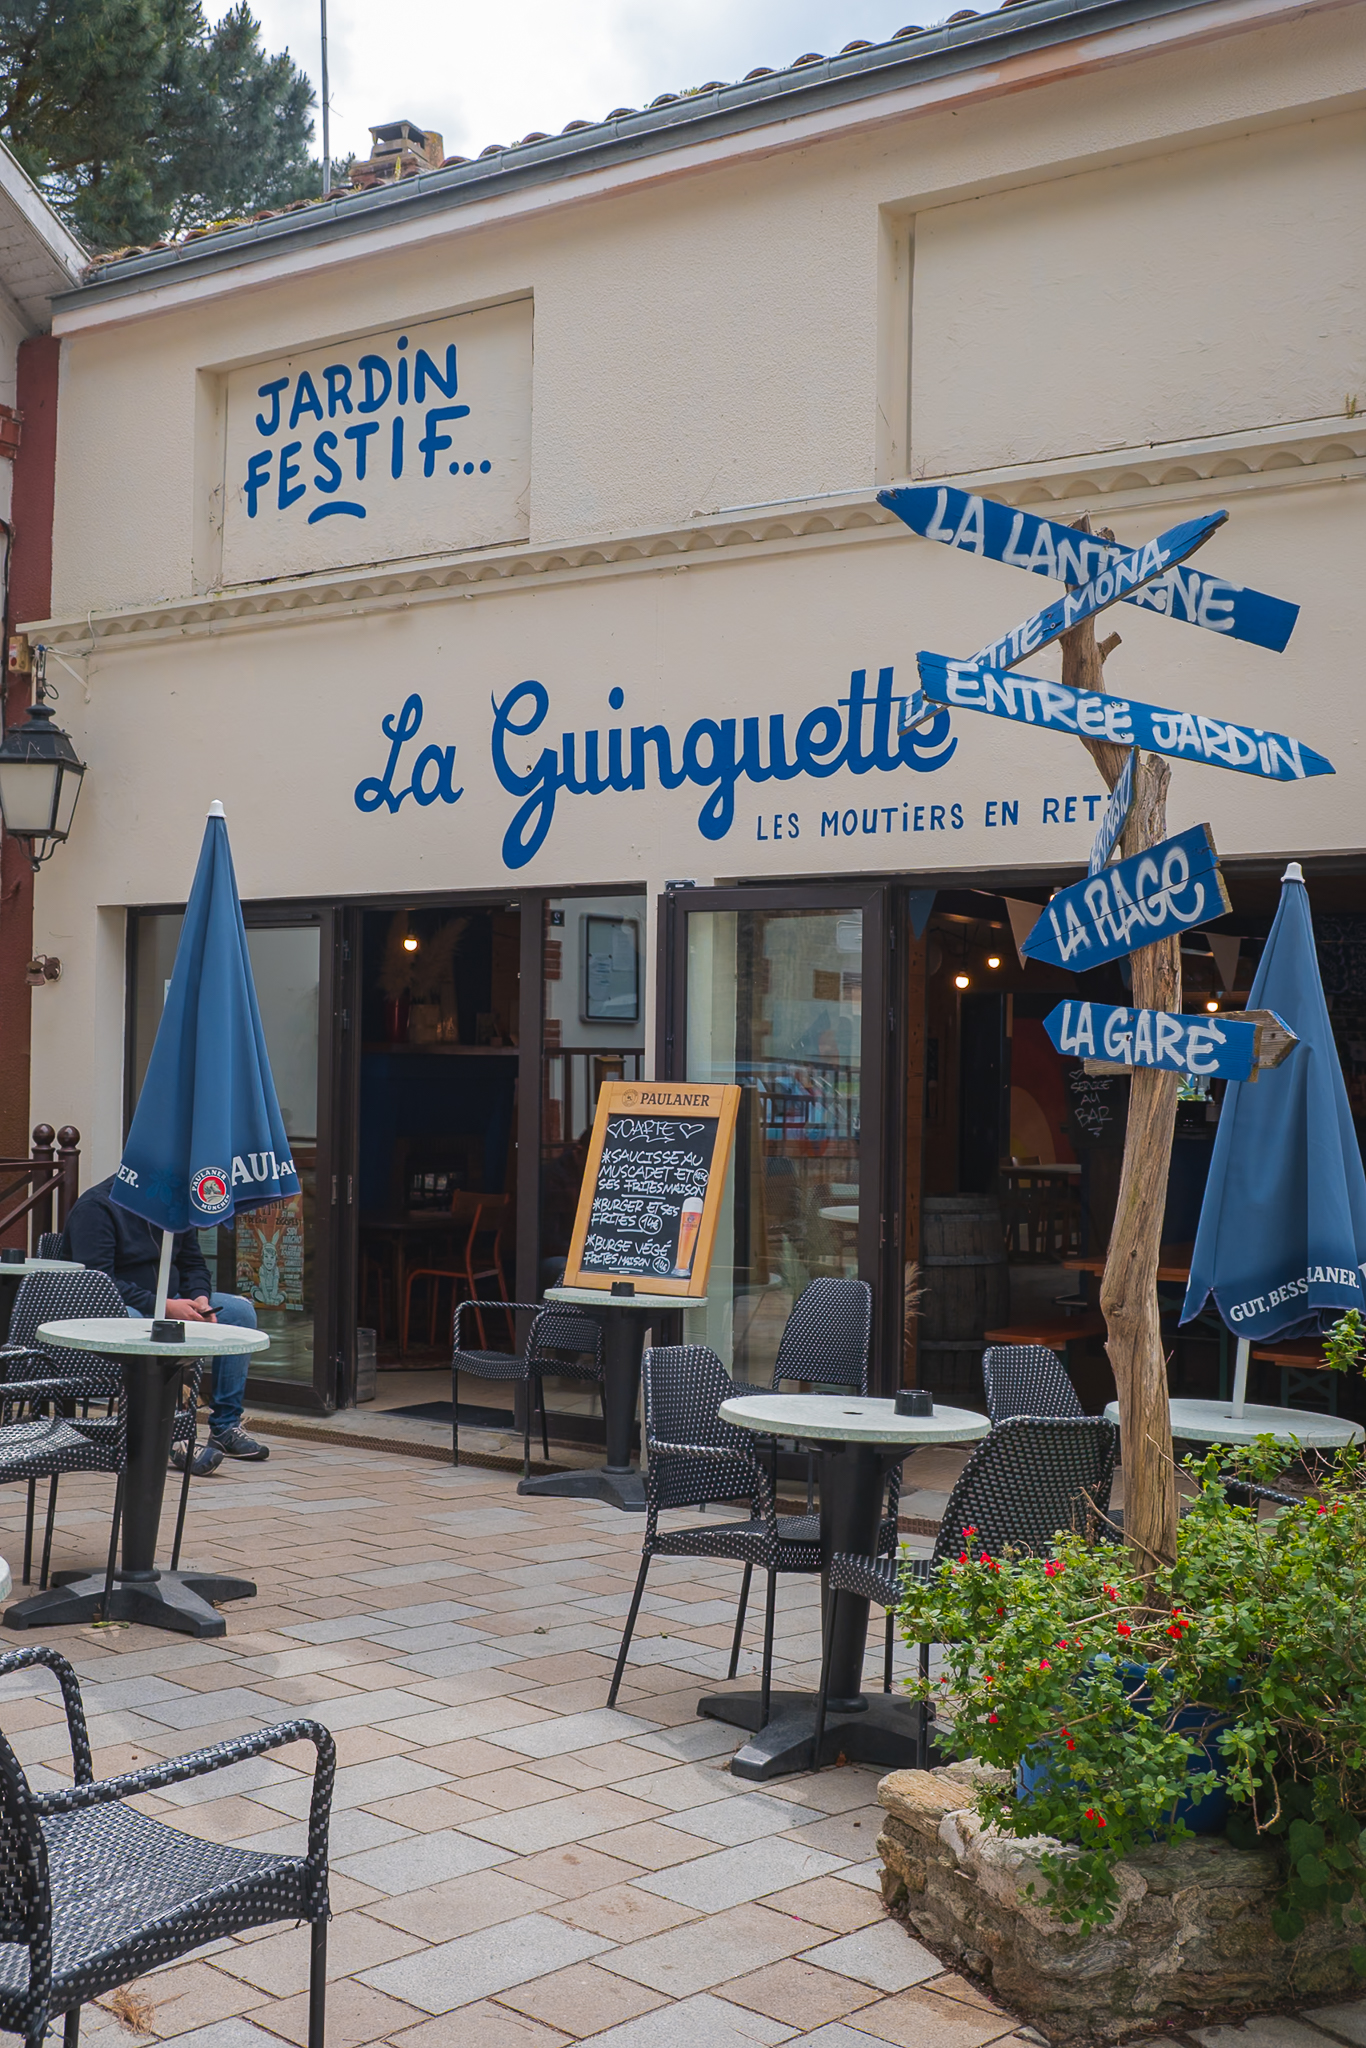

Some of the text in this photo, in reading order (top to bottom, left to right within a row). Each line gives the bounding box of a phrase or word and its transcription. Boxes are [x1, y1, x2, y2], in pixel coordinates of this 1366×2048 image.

[926, 487, 985, 556] LA
[1064, 538, 1171, 628] MONA
[354, 693, 464, 814] La
[491, 665, 958, 870] Guinguette
[756, 813, 799, 841] LES
[985, 798, 1018, 828] EN
[1042, 793, 1112, 824] RET
[1049, 902, 1092, 961] LA
[1060, 1002, 1095, 1055] LA
[640, 1092, 710, 1107] PAULANER
[1081, 1092, 1100, 1105] AU
[1075, 1106, 1113, 1128] BAR
[680, 1152, 703, 1166] AU
[191, 1169, 227, 1191] PAULANER
[598, 1164, 675, 1182] MUSCADET
[674, 1168, 694, 1183] ET
[598, 1179, 705, 1197] SES FRITES MAISON
[646, 1201, 663, 1214] ET
[660, 1204, 680, 1217] SES
[591, 1212, 637, 1227] FRITES
[635, 1239, 672, 1256] VÉGÉ
[584, 1251, 618, 1265] FRITES
[617, 1256, 650, 1267] MAISON
[1229, 1297, 1271, 1322] GUT,
